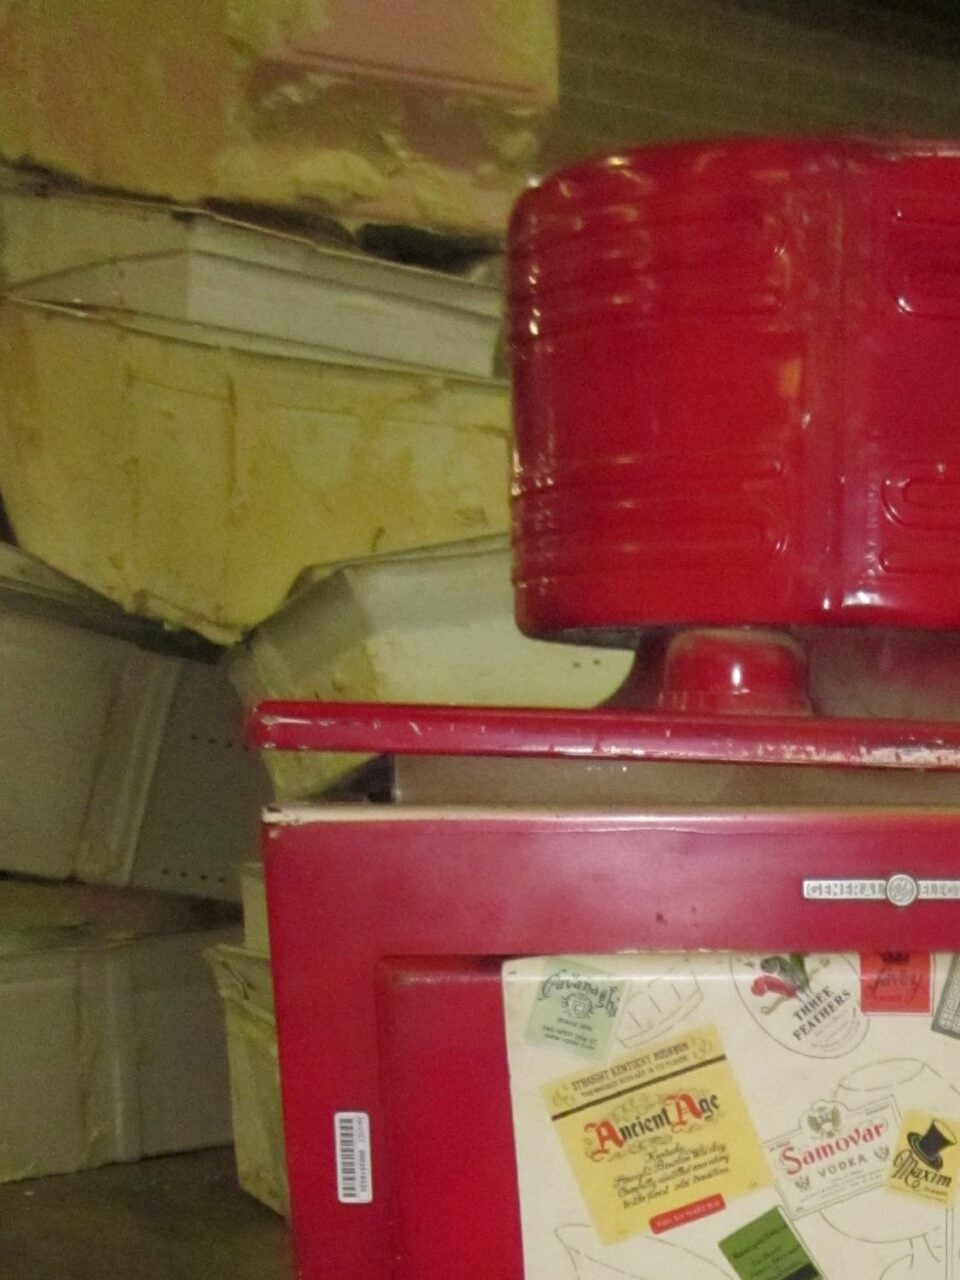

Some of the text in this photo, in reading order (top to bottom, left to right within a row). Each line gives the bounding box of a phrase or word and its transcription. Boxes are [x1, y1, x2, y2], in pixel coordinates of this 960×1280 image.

[806, 883, 884, 897] GENERAL
[792, 988, 851, 1041] FEATHERS
[793, 985, 834, 1021] THREE
[571, 1067, 610, 1092] STRAIGHT
[609, 1056, 651, 1080] KENTUCKY
[652, 1041, 690, 1063] BOURBON
[584, 1091, 721, 1162] Ancient Age
[782, 1121, 885, 1176] Samovar
[818, 1154, 868, 1178] VODKA
[891, 1149, 952, 1191] Maxim
